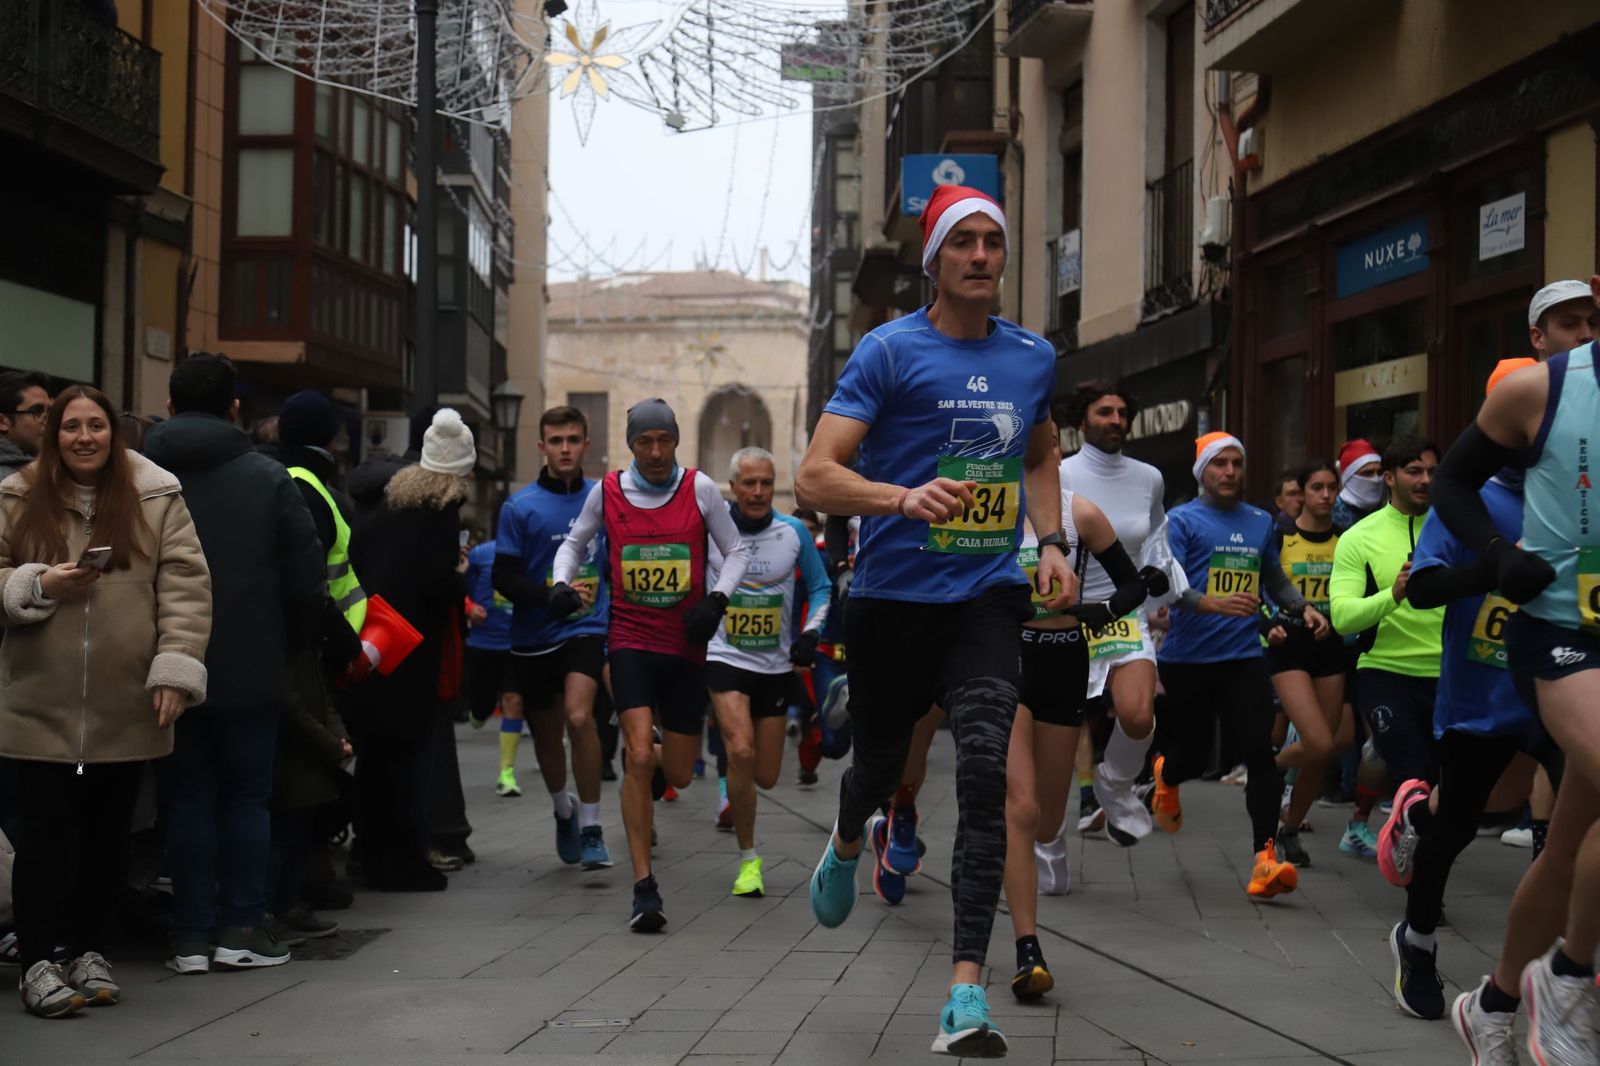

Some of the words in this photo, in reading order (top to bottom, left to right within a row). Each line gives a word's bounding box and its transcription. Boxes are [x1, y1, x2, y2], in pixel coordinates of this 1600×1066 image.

[1482, 206, 1499, 229] La
[1500, 205, 1522, 225] mer
[1364, 239, 1405, 270] NUXE
[966, 375, 989, 393] 46
[937, 400, 955, 409] SAN
[956, 400, 995, 410] SILVESTRE
[1144, 400, 1189, 437] WORLD
[965, 469, 983, 478] CAJA
[956, 537, 981, 548] CAJA
[982, 536, 1010, 547] RURAL
[1230, 533, 1244, 544] 46
[626, 567, 680, 592] 1324
[1213, 570, 1254, 593] 1072
[729, 612, 774, 636] 1255
[1038, 630, 1080, 644] PRO
